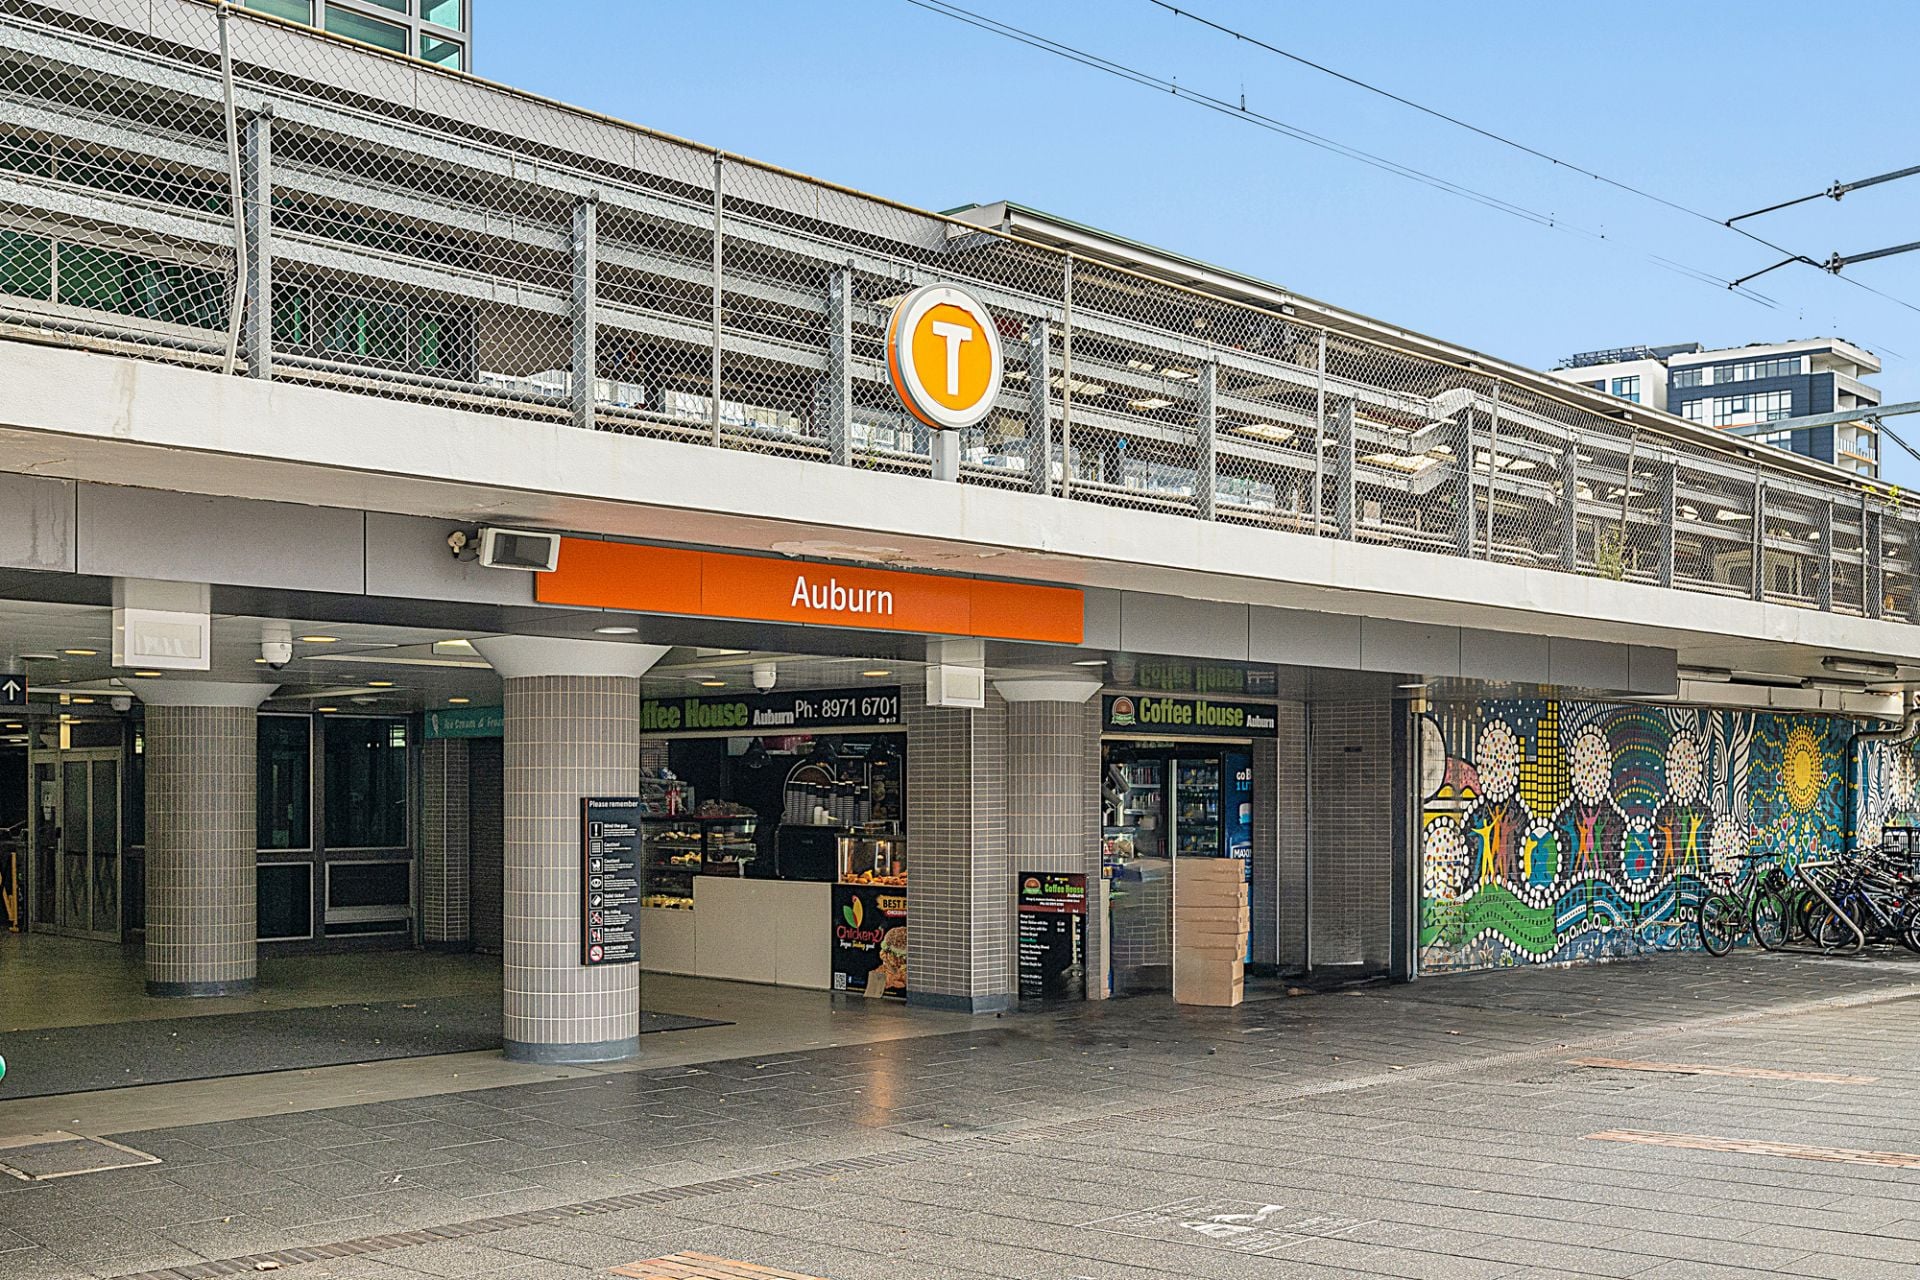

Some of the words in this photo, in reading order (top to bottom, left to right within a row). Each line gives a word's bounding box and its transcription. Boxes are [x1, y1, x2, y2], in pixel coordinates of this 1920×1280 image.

[932, 320, 973, 396] T
[791, 575, 894, 615] Auburn
[640, 700, 681, 729] ffee
[685, 698, 748, 728] House
[753, 708, 794, 726] Auburn
[795, 699, 818, 719] Ph:
[821, 697, 856, 718] 8971
[861, 696, 897, 716] 6701
[1139, 697, 1192, 725] Coffee
[1196, 700, 1243, 727] House
[1246, 714, 1275, 729] Auburn
[589, 800, 609, 808] Please
[609, 800, 639, 808] remember
[882, 899, 901, 909] BEST
[1044, 883, 1065, 894] Coffee
